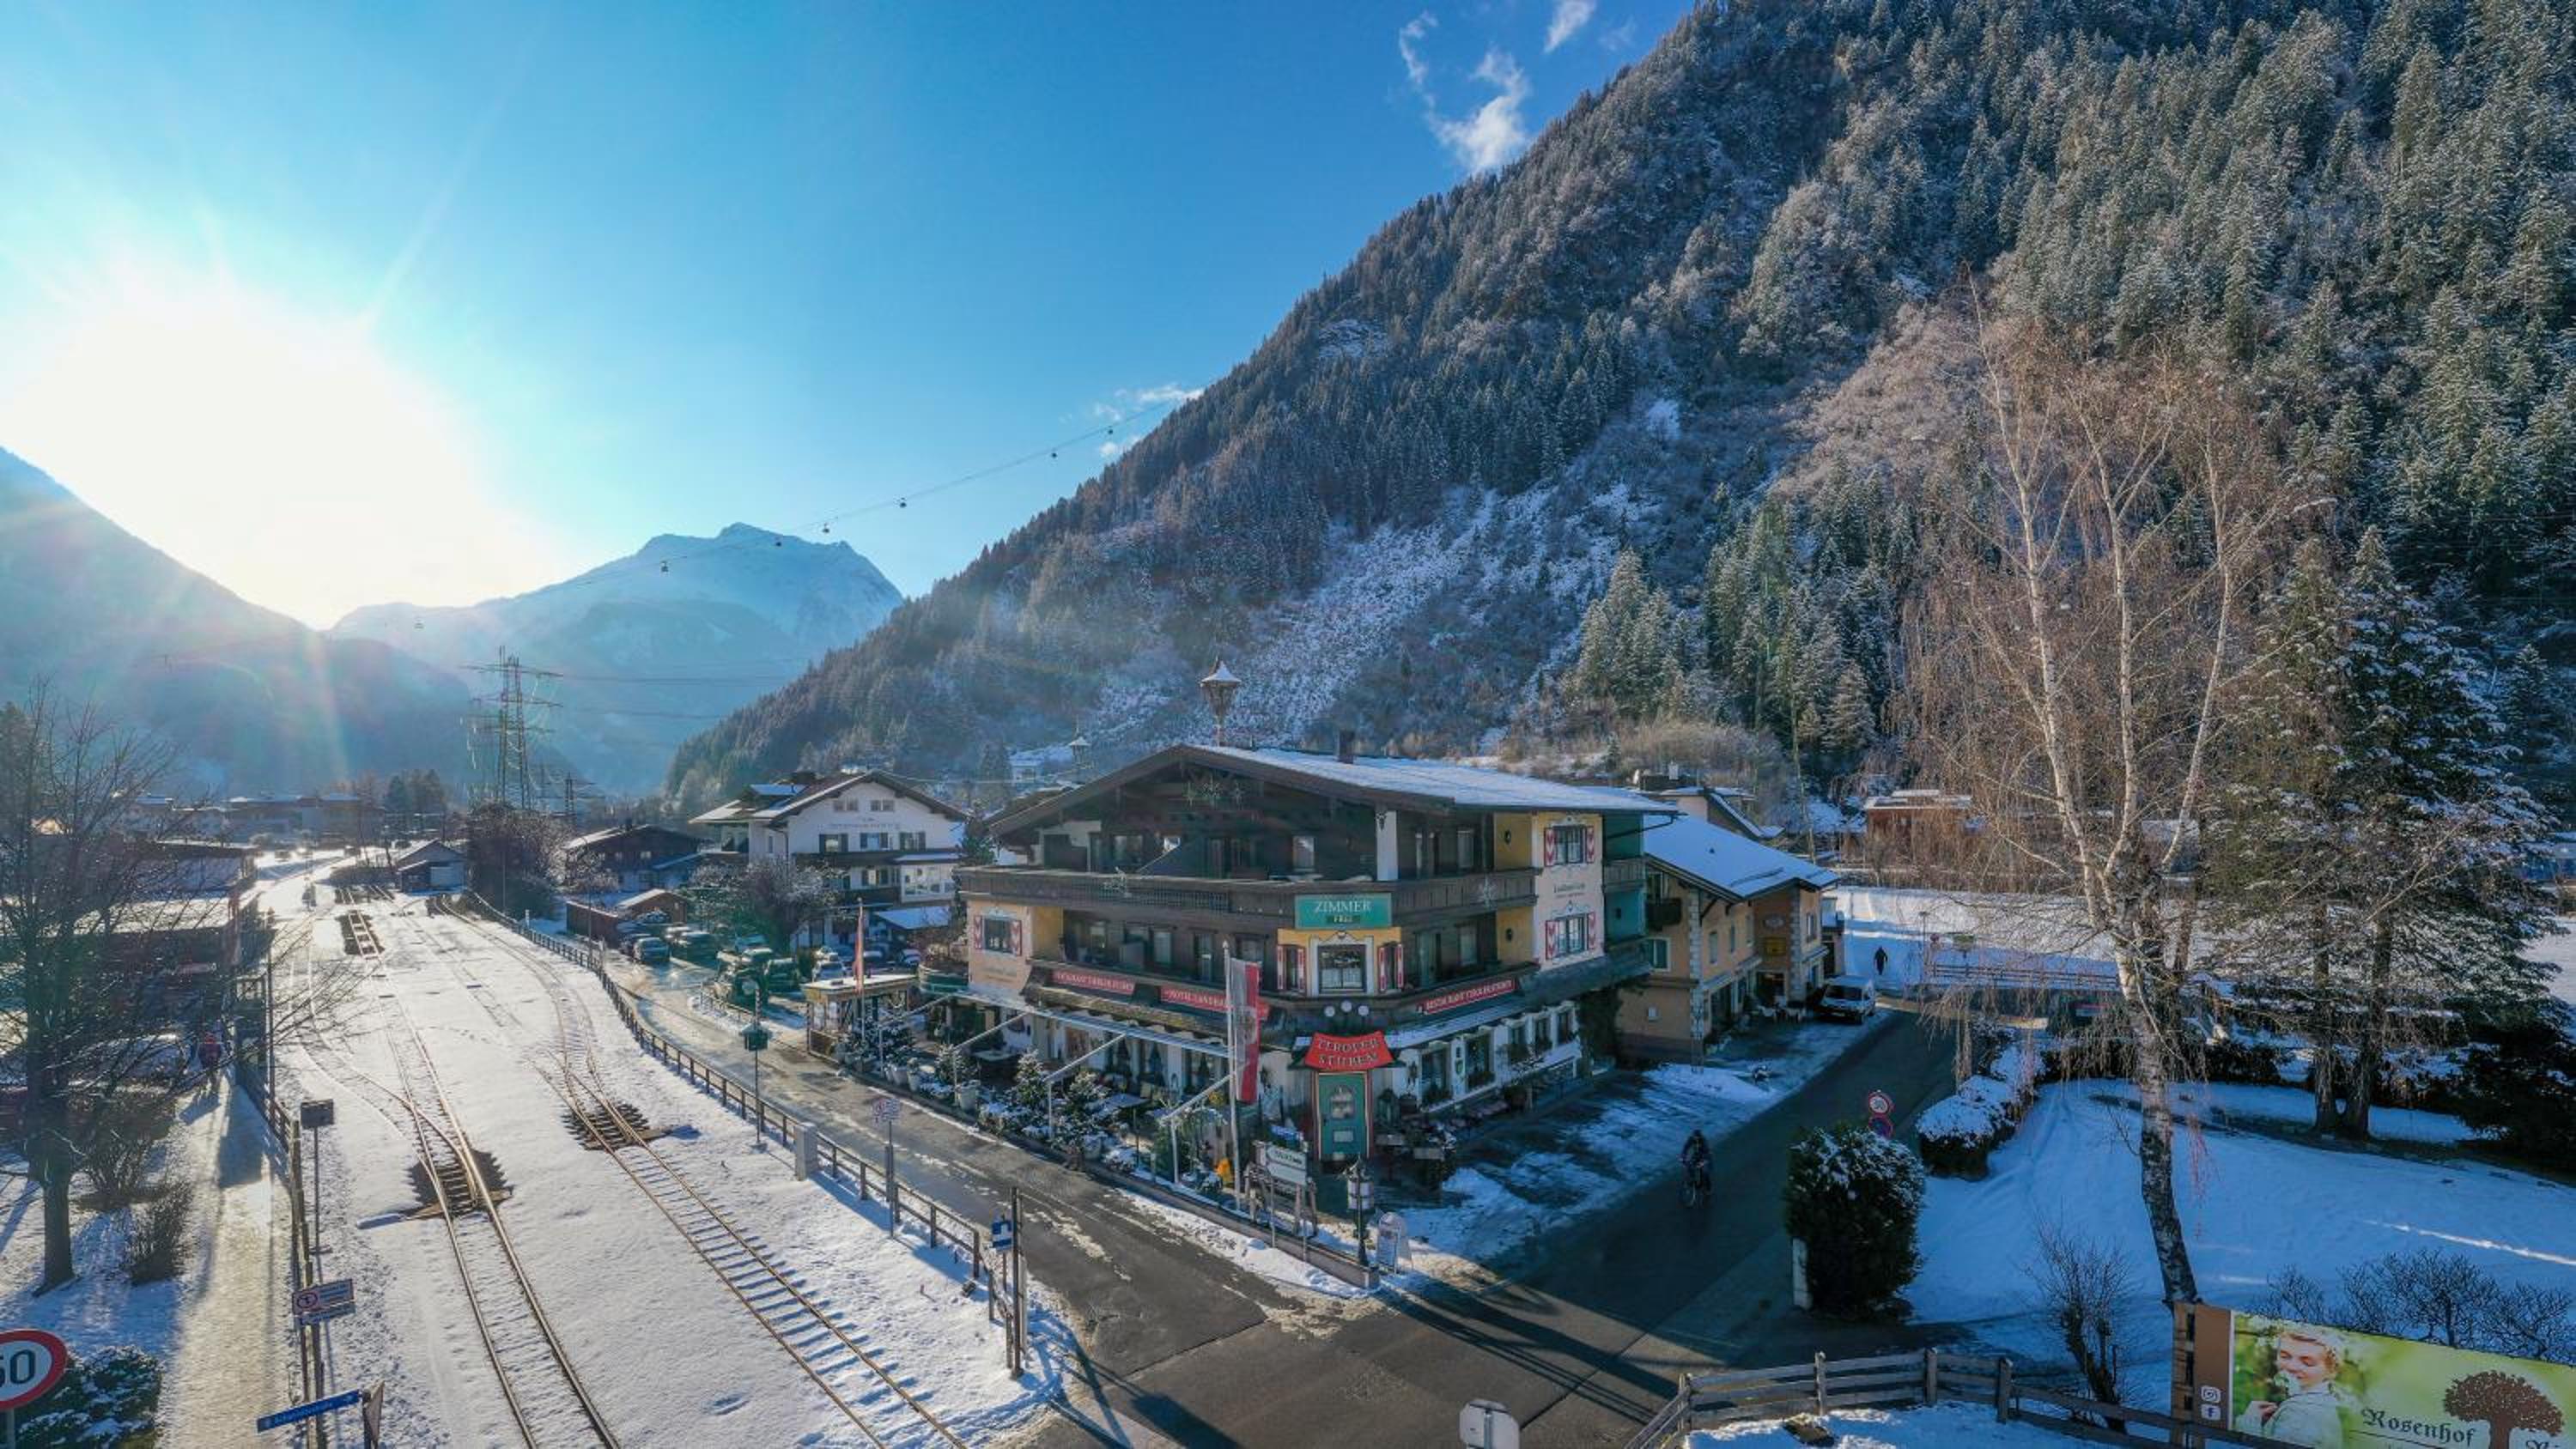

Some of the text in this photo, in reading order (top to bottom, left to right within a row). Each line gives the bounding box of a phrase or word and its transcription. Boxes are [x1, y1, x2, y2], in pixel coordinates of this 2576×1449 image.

[1313, 900, 1372, 913] ZIMMER
[0, 1349, 36, 1387] 0
[2361, 1407, 2476, 1446] Rosenhof
